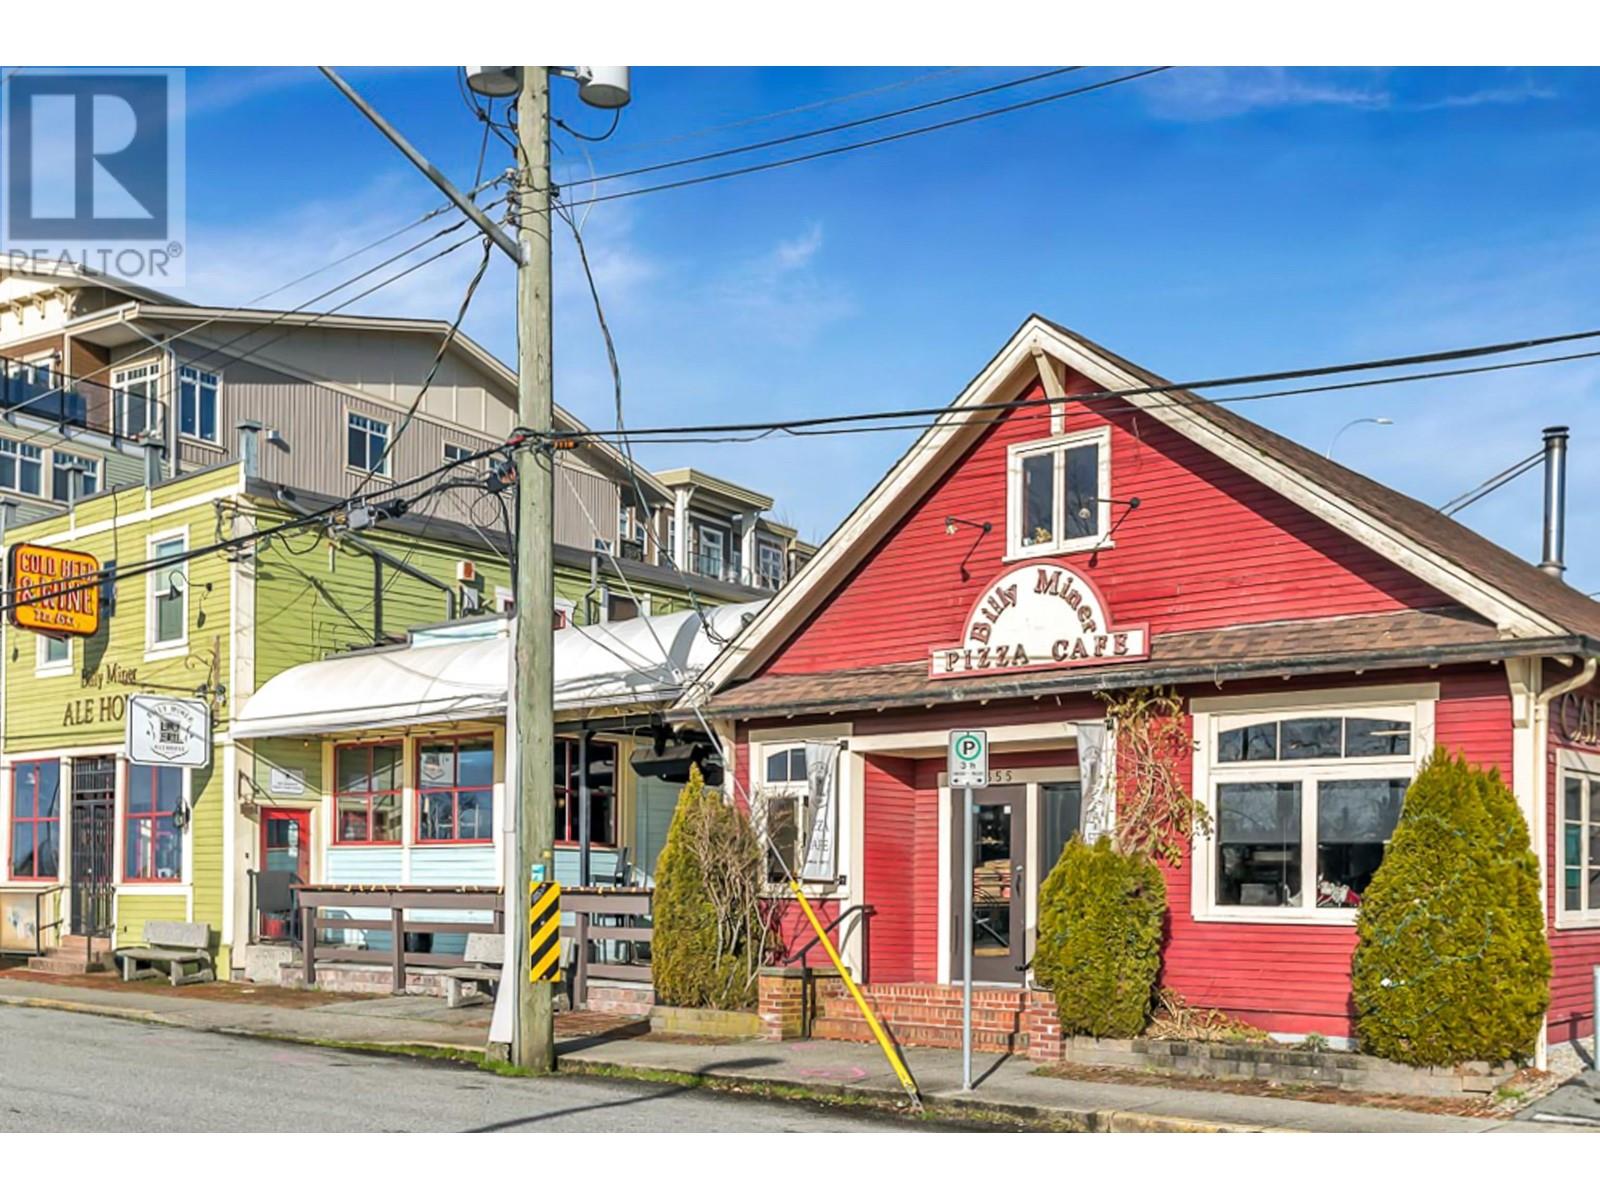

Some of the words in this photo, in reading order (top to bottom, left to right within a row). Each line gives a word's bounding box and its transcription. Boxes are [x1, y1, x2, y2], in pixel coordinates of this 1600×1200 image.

[21, 553, 55, 577] COLD
[970, 584, 1018, 645] Billy
[1034, 568, 1096, 634] Miner
[945, 644, 1029, 671] PIZZA
[1051, 633, 1128, 661] CAFE
[63, 698, 94, 727] ALE
[963, 740, 976, 755] P
